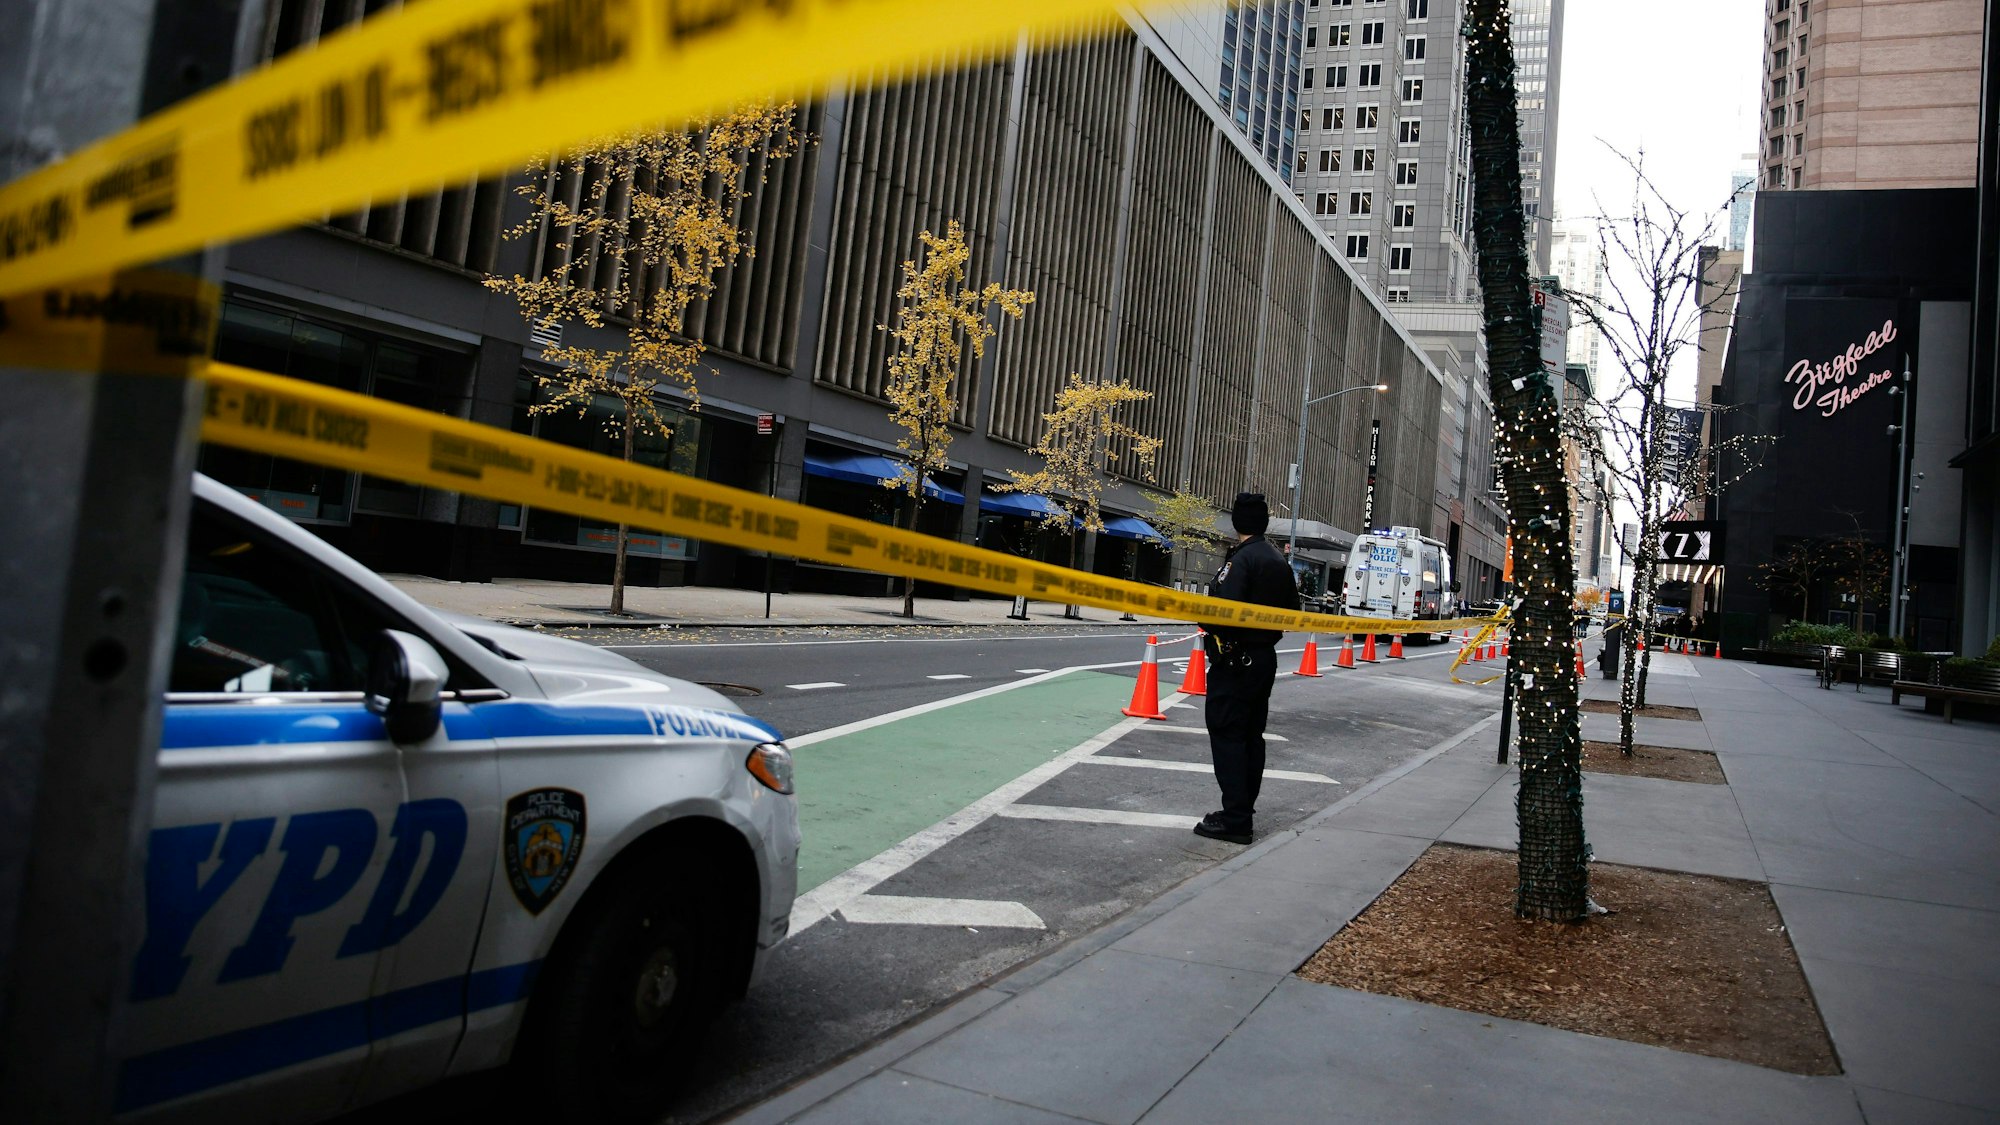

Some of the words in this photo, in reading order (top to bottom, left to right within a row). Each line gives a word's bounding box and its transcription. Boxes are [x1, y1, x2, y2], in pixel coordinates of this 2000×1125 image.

[1541, 316, 1563, 328] MERCIAL
[1784, 319, 1898, 411] Ziegfeld
[1816, 368, 1893, 418] Theatre
[1370, 427, 1379, 466] Hilton
[1030, 510, 1041, 518] BAR
[1365, 485, 1374, 520] PARK
[1369, 553, 1397, 563] POLIC
[1372, 545, 1398, 556] NYPD
[1673, 533, 1690, 559] Z
[1613, 599, 1620, 608] P
[642, 703, 739, 740] POLICE
[528, 792, 566, 807] POLICE
[511, 804, 582, 829] DEPARTMENT
[131, 798, 469, 1002] YPD
